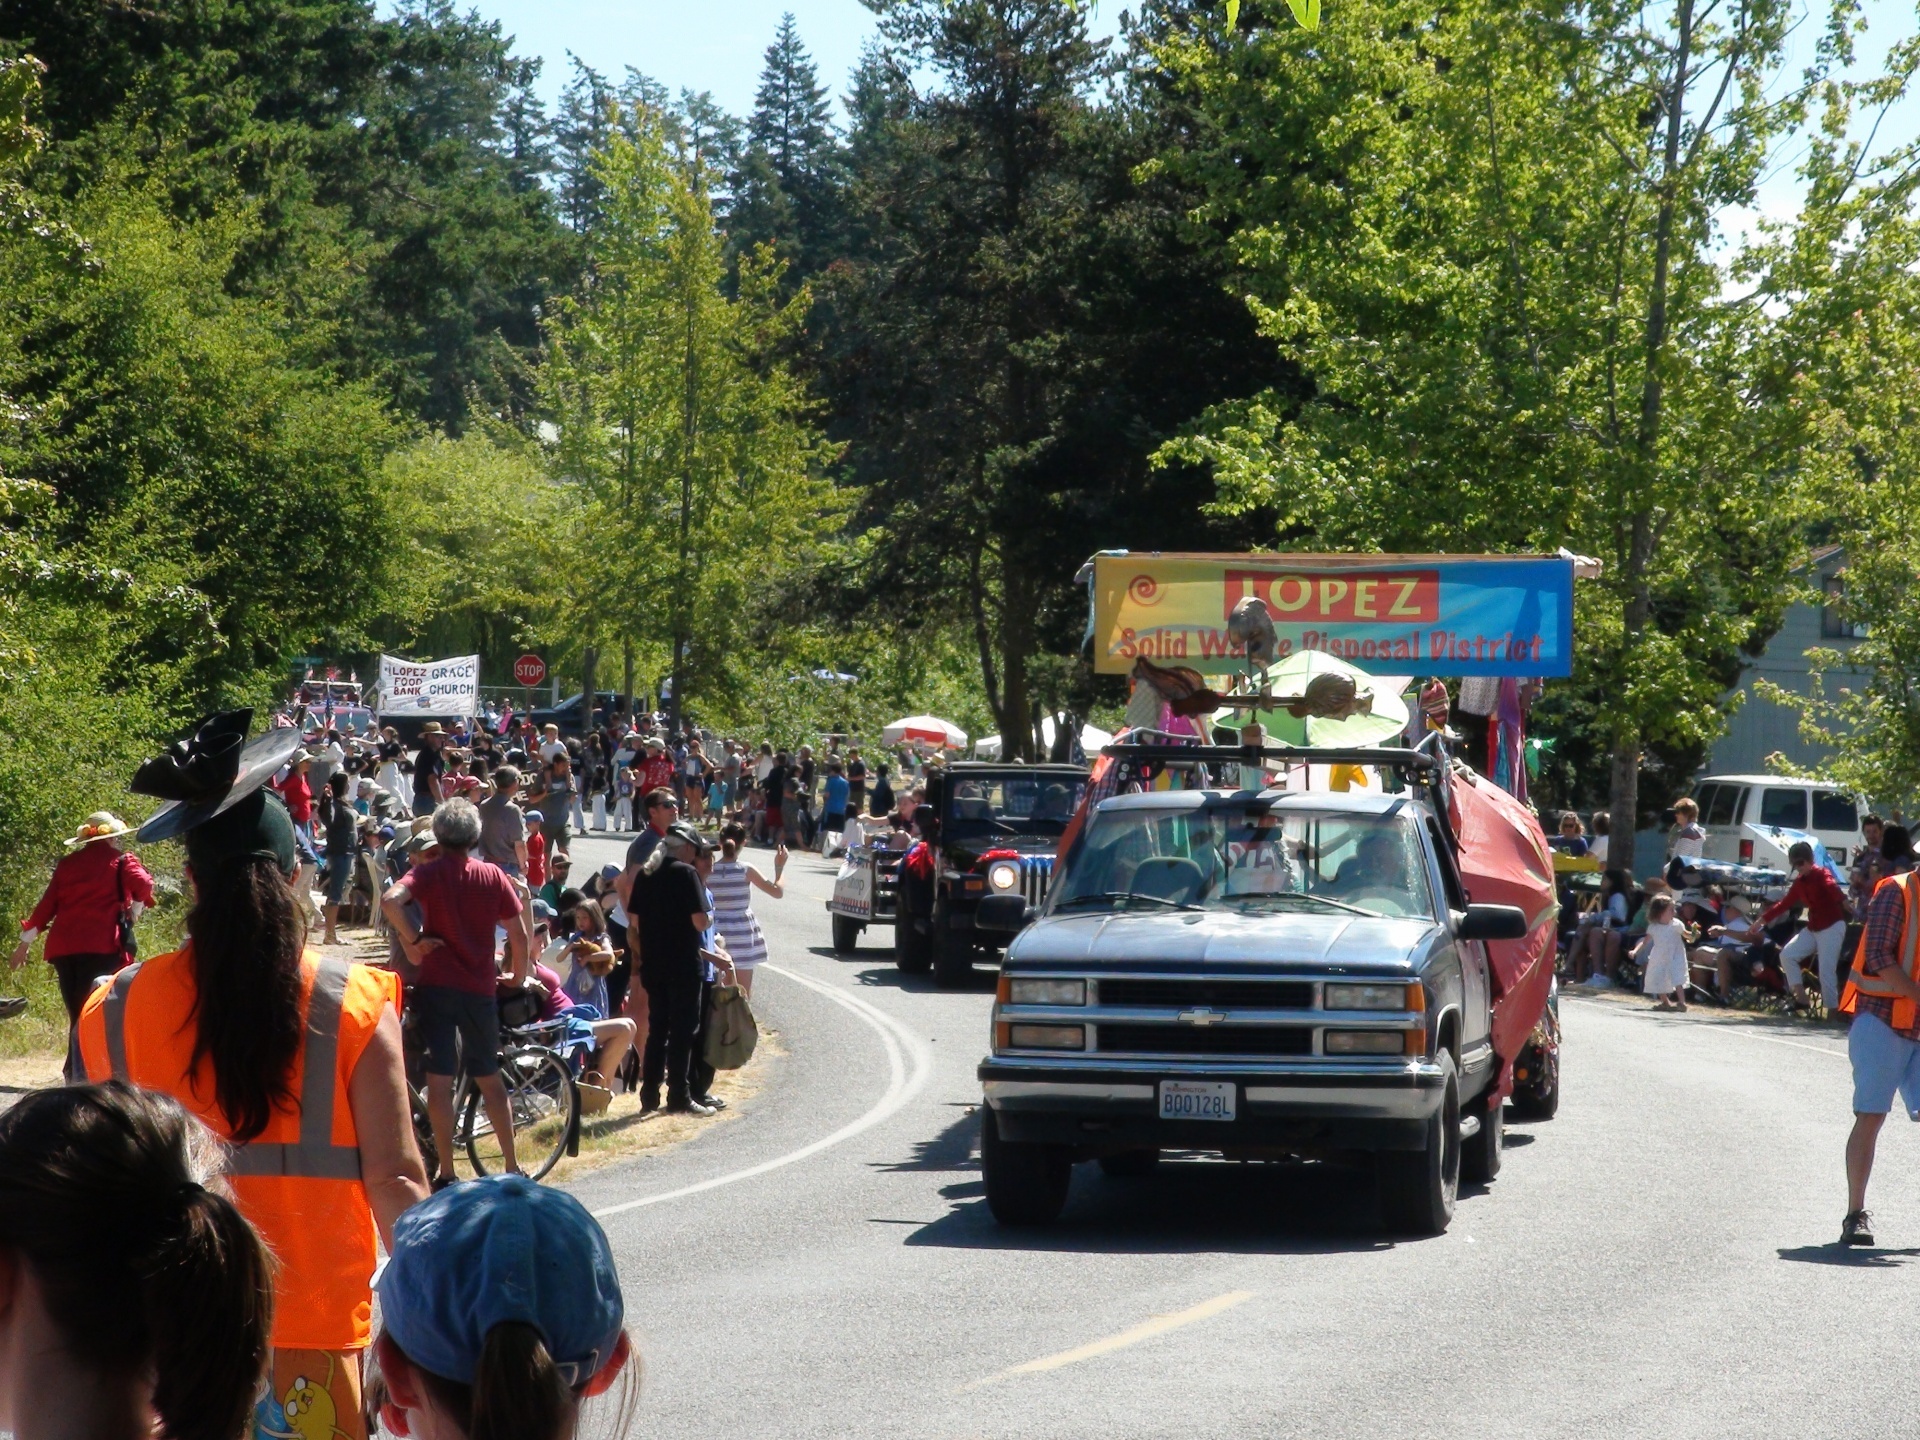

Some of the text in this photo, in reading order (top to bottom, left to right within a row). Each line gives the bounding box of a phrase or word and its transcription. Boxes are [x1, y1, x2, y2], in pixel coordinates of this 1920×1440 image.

[1119, 627, 1545, 663] Solid Wae Disposal District
[392, 665, 473, 680] LOPEZ GRACE
[516, 664, 543, 677] STOP
[394, 677, 423, 687] FOOD
[393, 683, 474, 696] BANK CHURCH
[1164, 1094, 1231, 1115] B00128L
